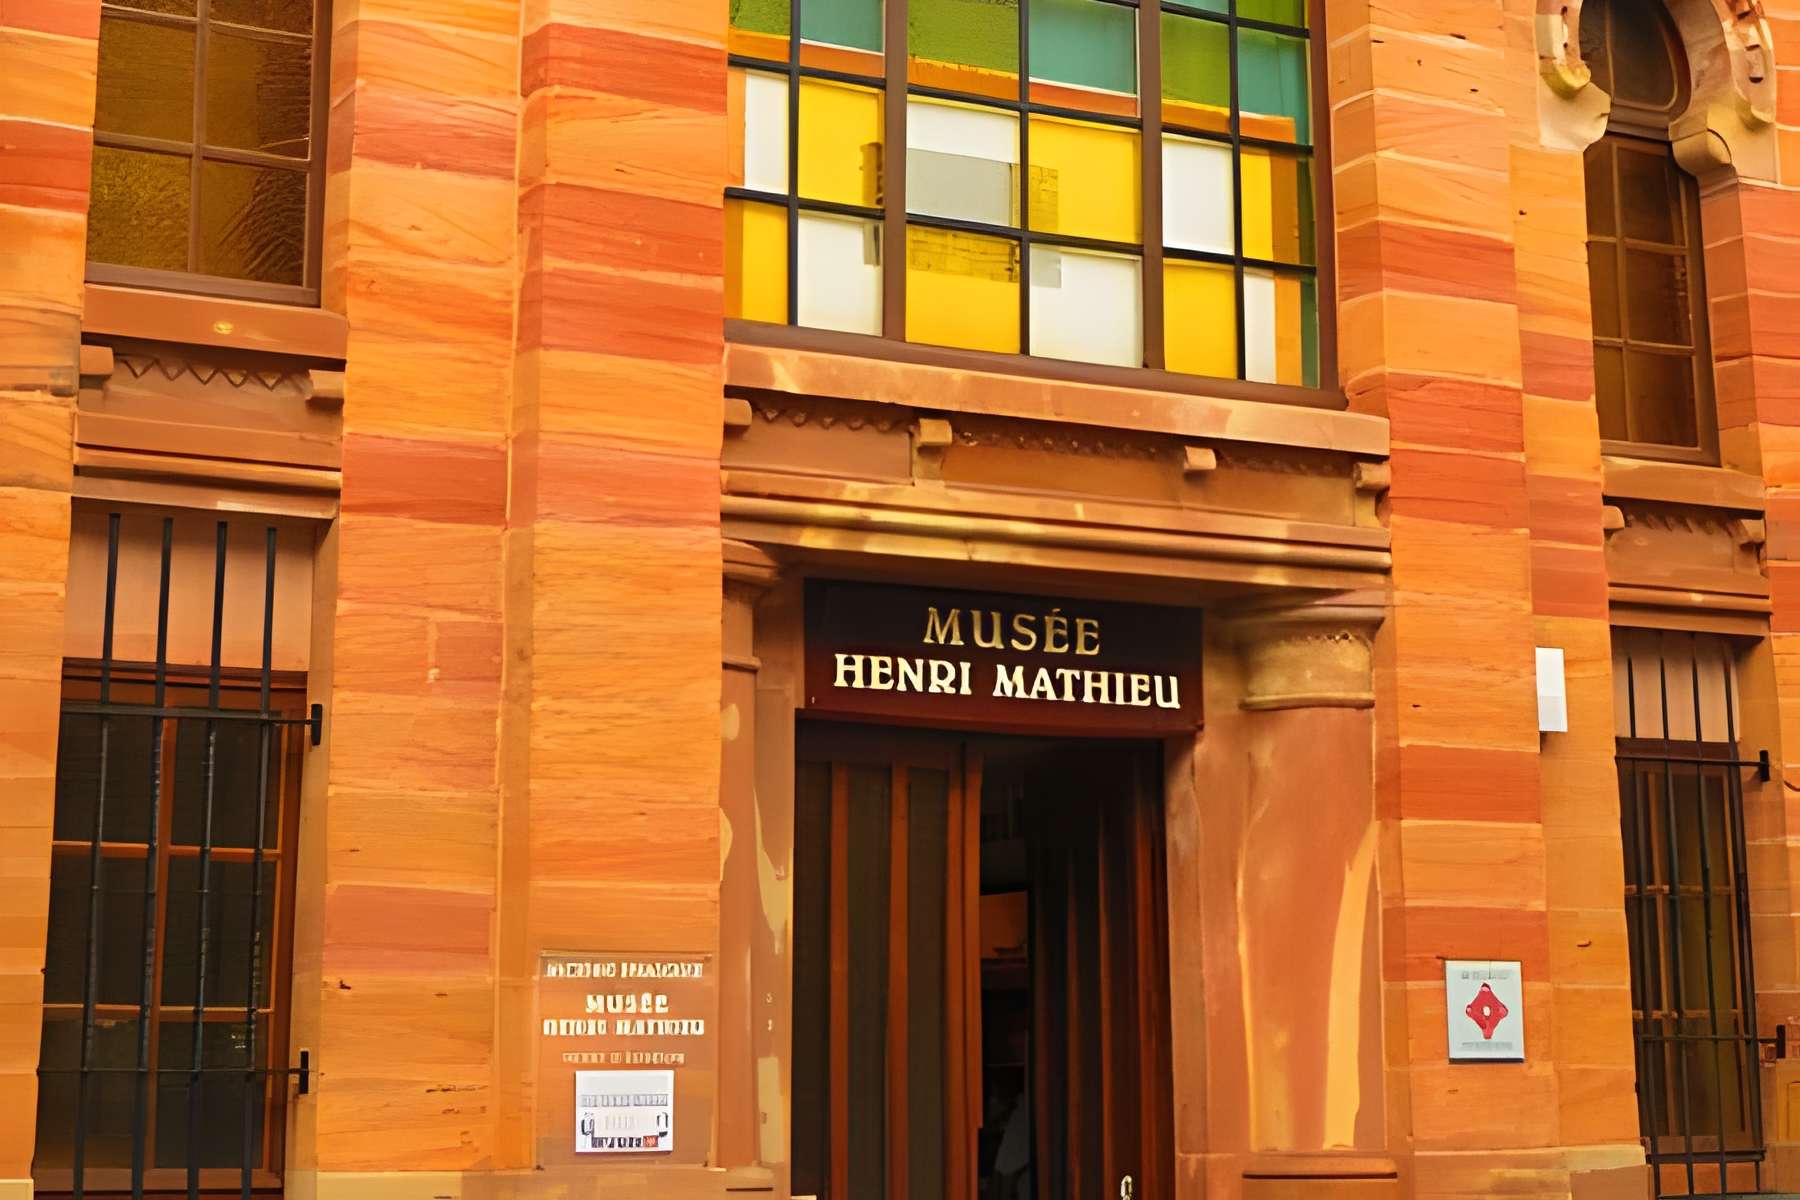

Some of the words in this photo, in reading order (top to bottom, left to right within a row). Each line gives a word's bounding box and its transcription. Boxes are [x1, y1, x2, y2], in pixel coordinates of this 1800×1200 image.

[923, 606, 1100, 656] MUSÉE
[833, 653, 972, 696] HENRI
[992, 664, 1181, 710] MATHIEU
